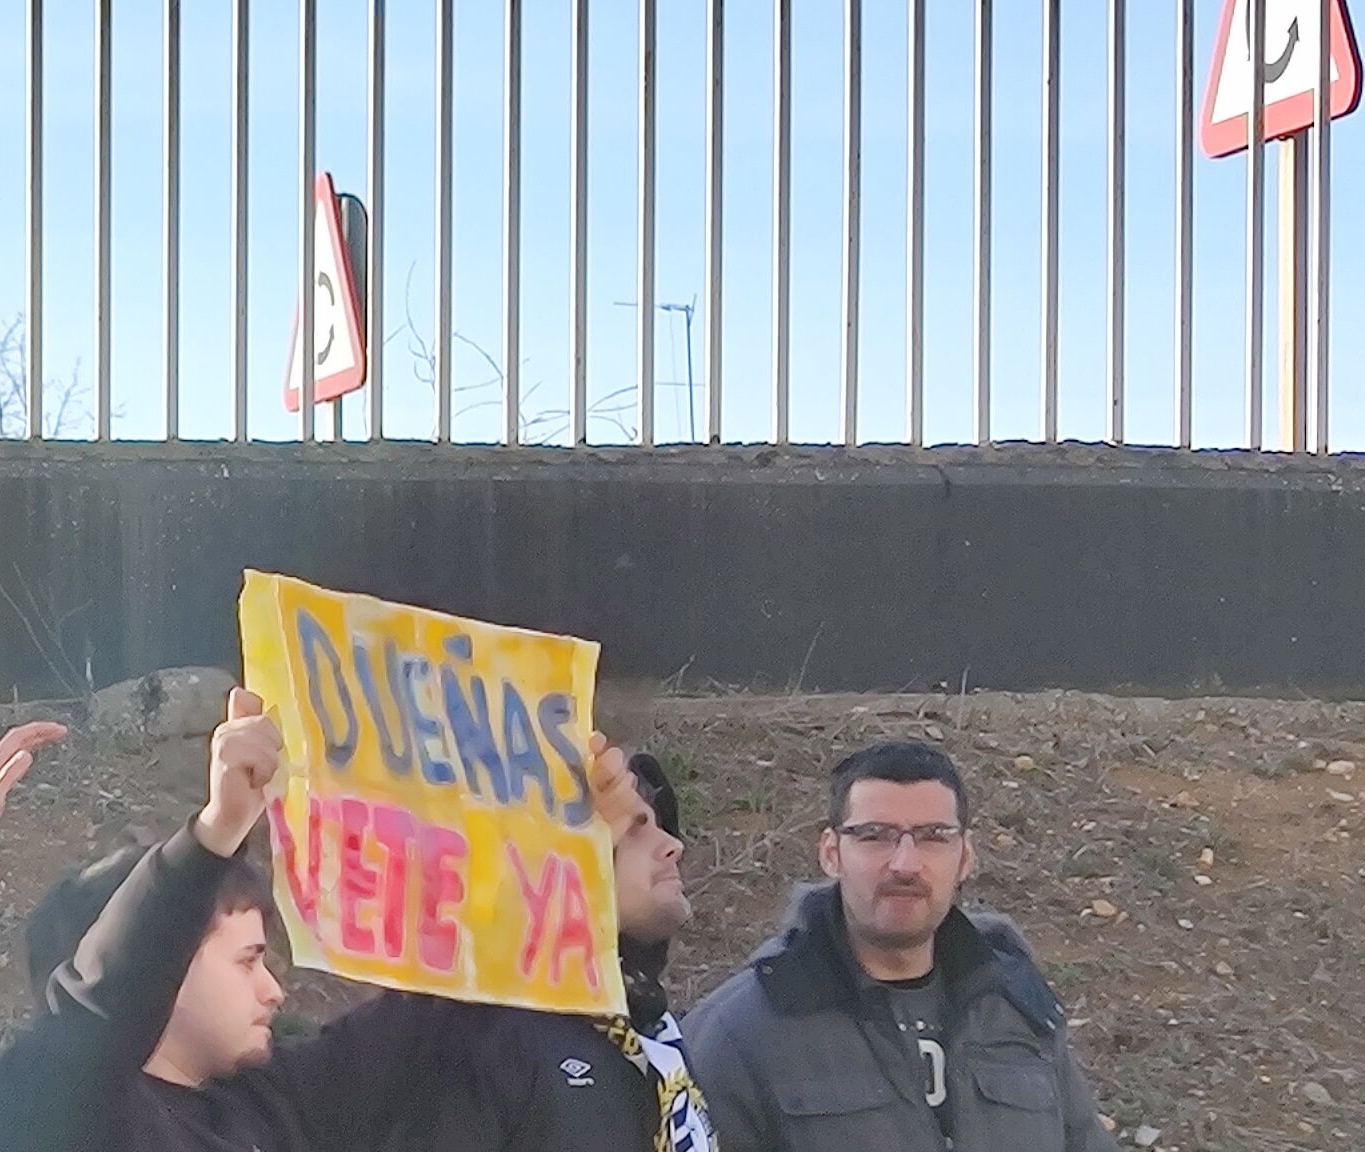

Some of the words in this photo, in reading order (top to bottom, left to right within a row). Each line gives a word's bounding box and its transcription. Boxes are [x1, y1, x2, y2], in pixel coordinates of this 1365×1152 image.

[297, 607, 595, 828] DUEÑAS
[269, 796, 467, 973] VETE
[506, 838, 599, 988] YA
